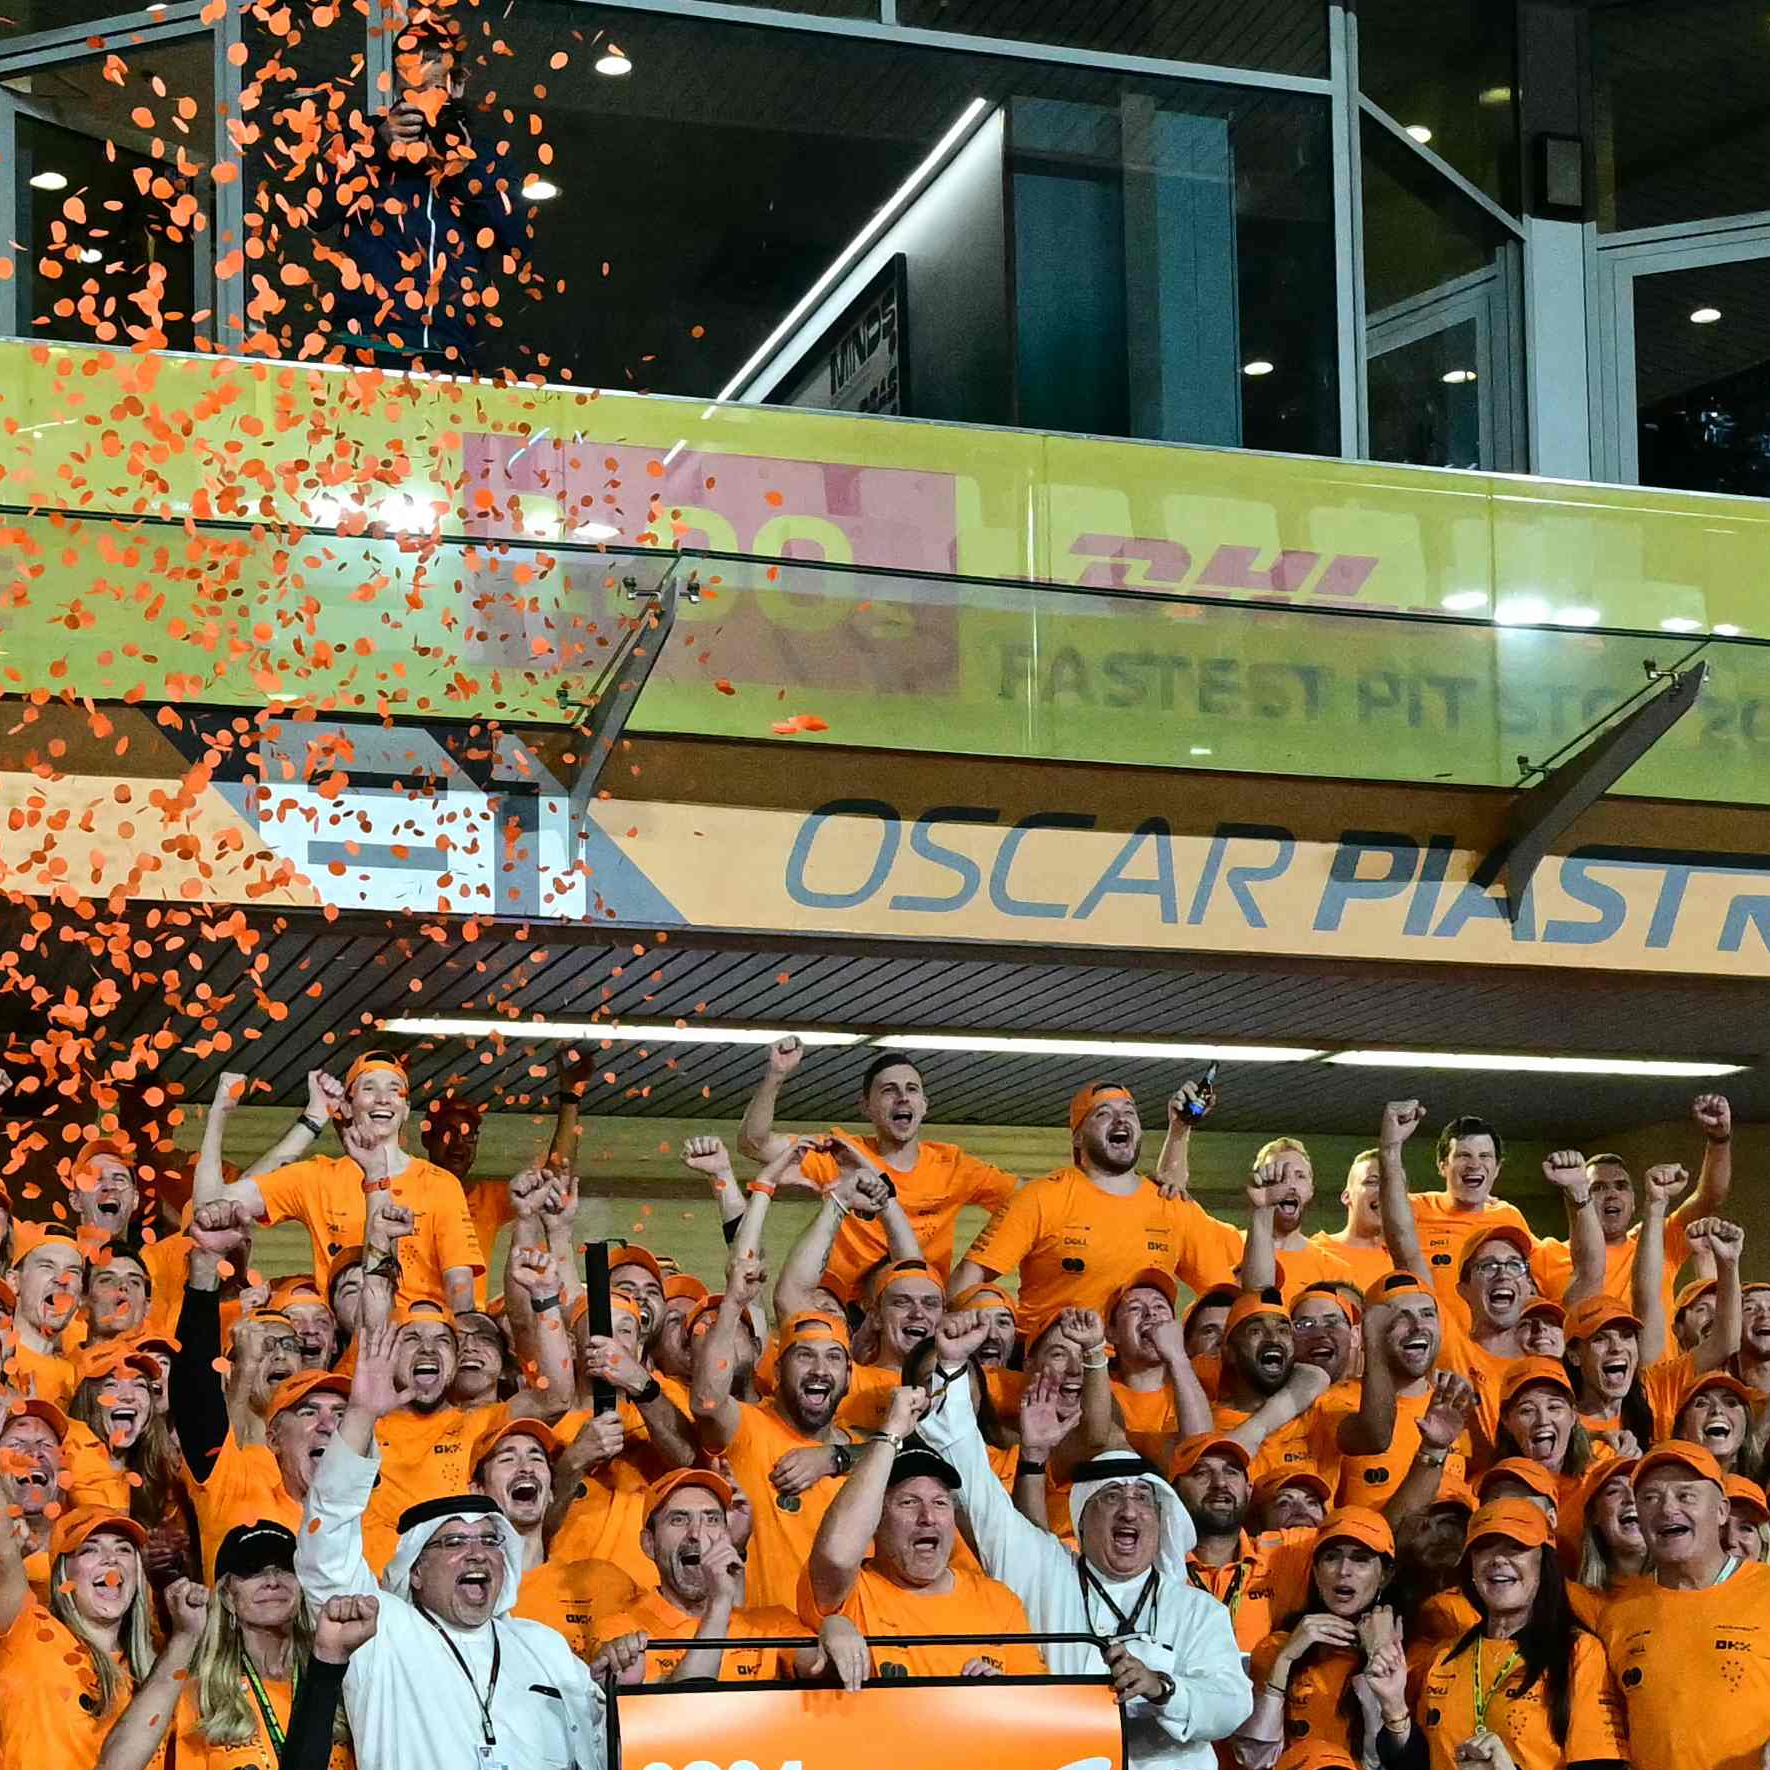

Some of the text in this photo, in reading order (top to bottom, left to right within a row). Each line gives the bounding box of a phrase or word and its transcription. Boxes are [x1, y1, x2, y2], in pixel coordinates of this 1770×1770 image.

[1068, 532, 1380, 606] DHL
[997, 640, 1336, 722] FASTEST
[1358, 668, 1478, 732] PIT
[784, 798, 1296, 930] OSCAR
